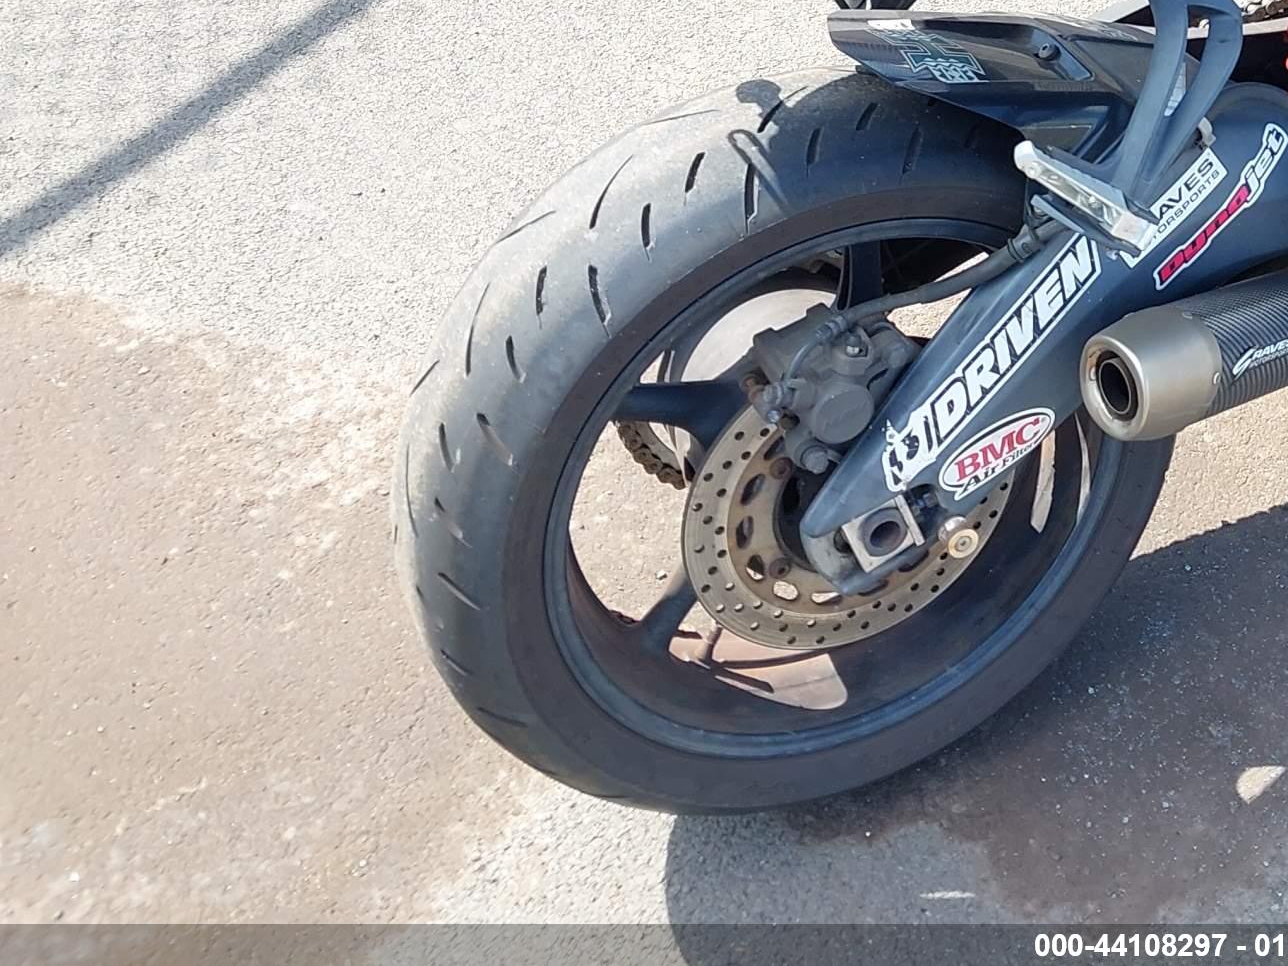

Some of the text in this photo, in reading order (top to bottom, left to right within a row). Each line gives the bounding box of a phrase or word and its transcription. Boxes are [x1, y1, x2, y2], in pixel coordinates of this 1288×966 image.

[1158, 157, 1214, 221] AVES
[934, 234, 1093, 442] DRIVEN
[954, 417, 1041, 482] BMC
[962, 463, 1000, 494] Air
